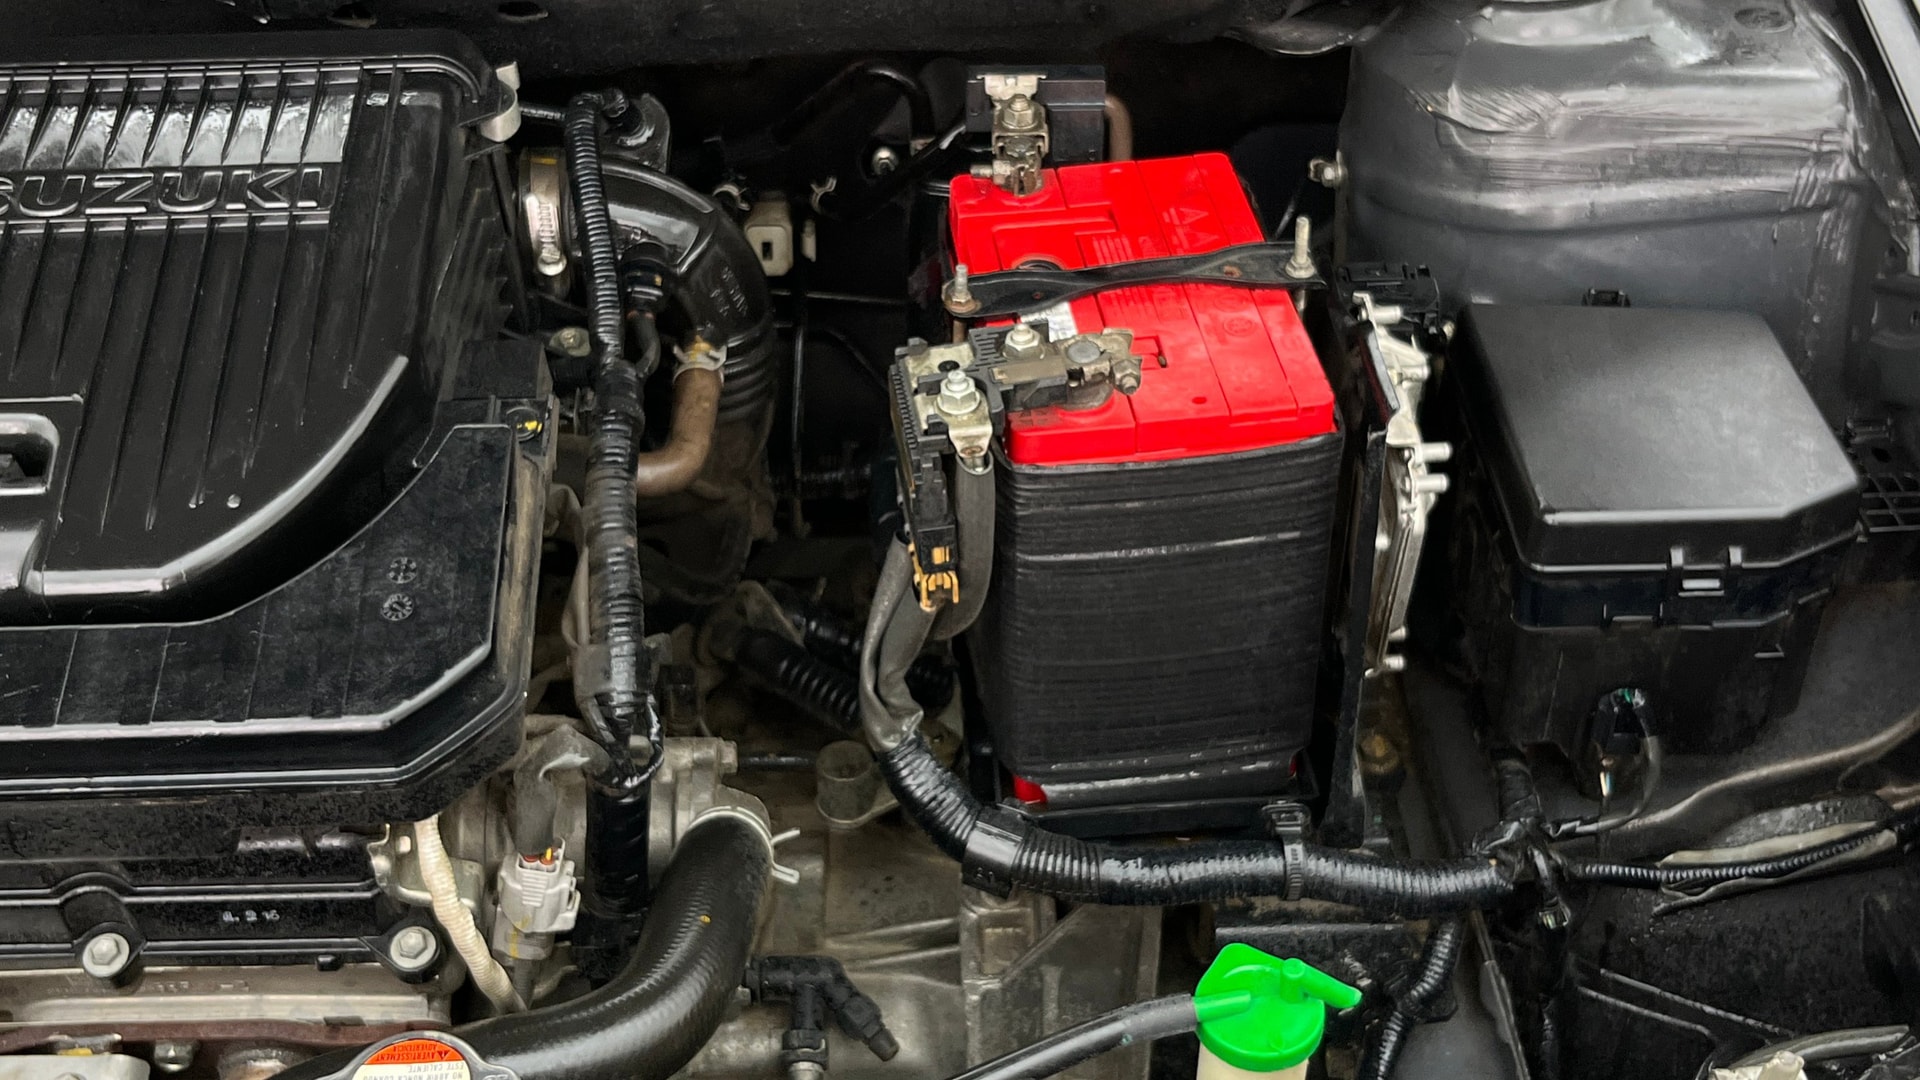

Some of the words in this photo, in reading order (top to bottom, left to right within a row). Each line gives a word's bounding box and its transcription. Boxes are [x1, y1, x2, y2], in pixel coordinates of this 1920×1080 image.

[0, 168, 323, 217] UZUKI
[393, 1043, 437, 1052] ADVERTENCIA
[376, 1050, 436, 1062] AVERTISSEMENT
[446, 1062, 464, 1071] ESTE
